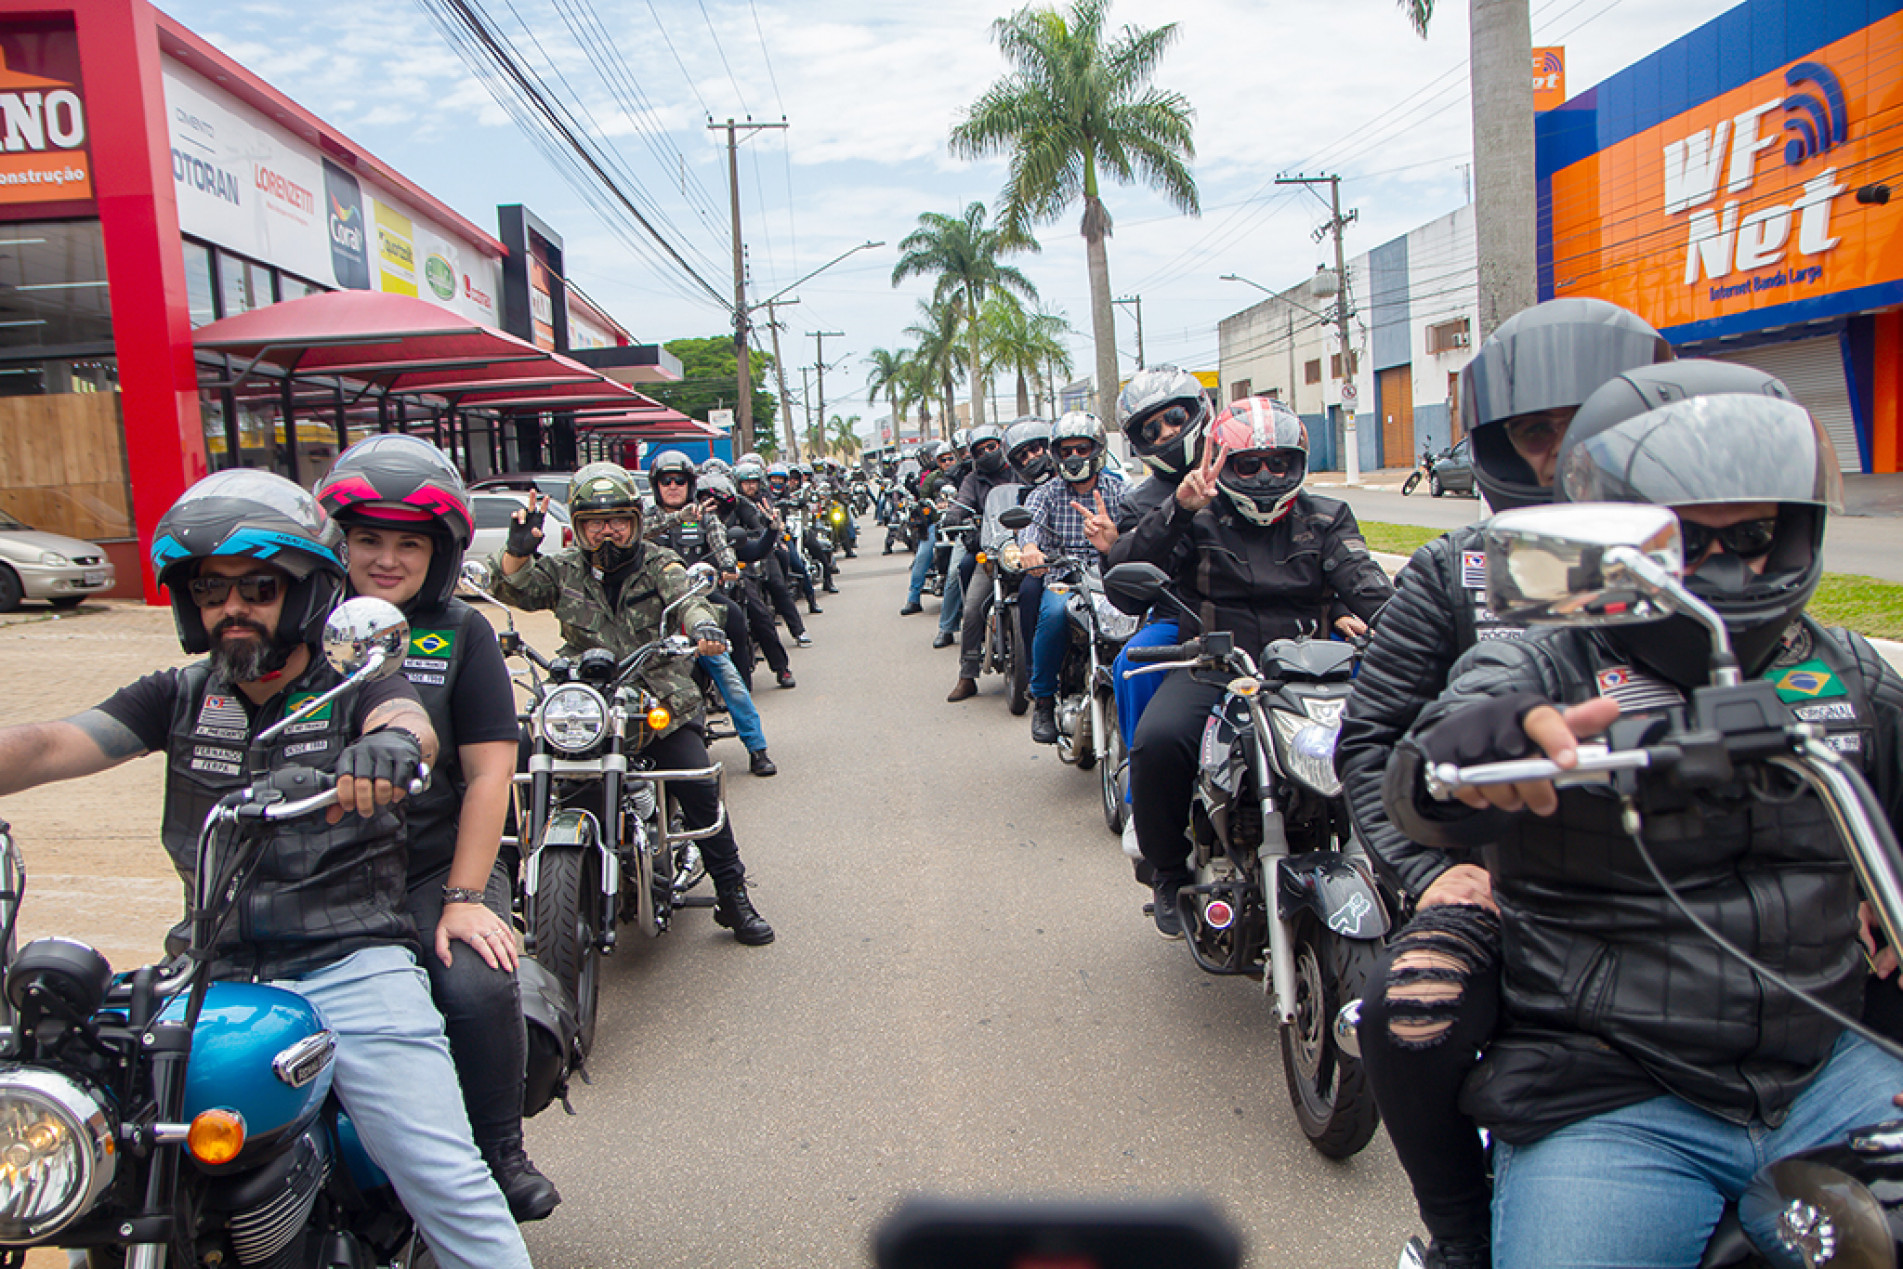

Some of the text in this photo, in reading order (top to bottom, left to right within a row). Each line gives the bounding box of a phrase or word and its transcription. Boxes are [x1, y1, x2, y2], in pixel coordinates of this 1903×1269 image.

[0, 89, 84, 151] NO
[0, 166, 85, 186] onstrução
[1663, 97, 1786, 216] WF
[254, 162, 315, 216] LORENZETTI
[1684, 166, 1849, 286] Net
[1709, 265, 1823, 301] Internet Banda Larga
